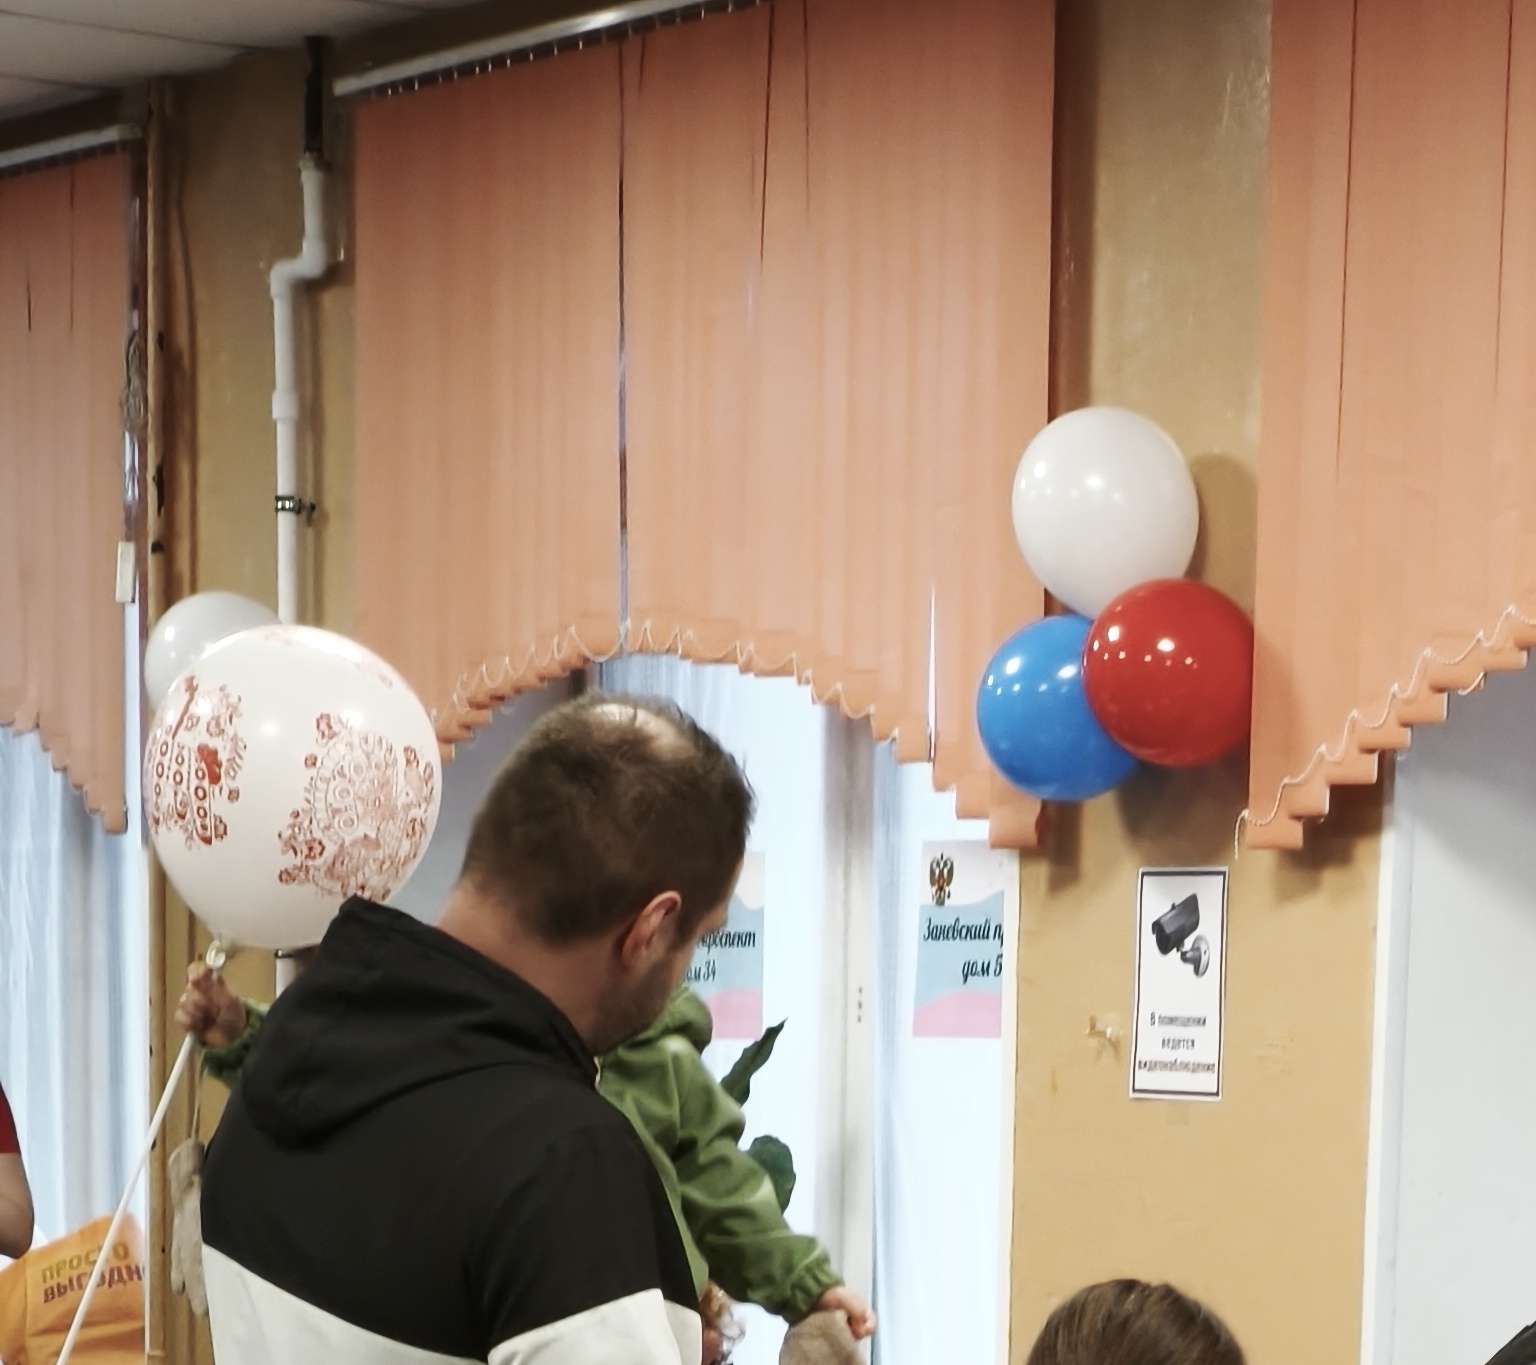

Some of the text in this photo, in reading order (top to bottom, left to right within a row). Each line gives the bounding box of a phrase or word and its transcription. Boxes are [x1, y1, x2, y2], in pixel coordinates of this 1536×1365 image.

[923, 916, 992, 942] Заневский
[961, 958, 992, 985] дом
[41, 1242, 130, 1284] ПРОСО
